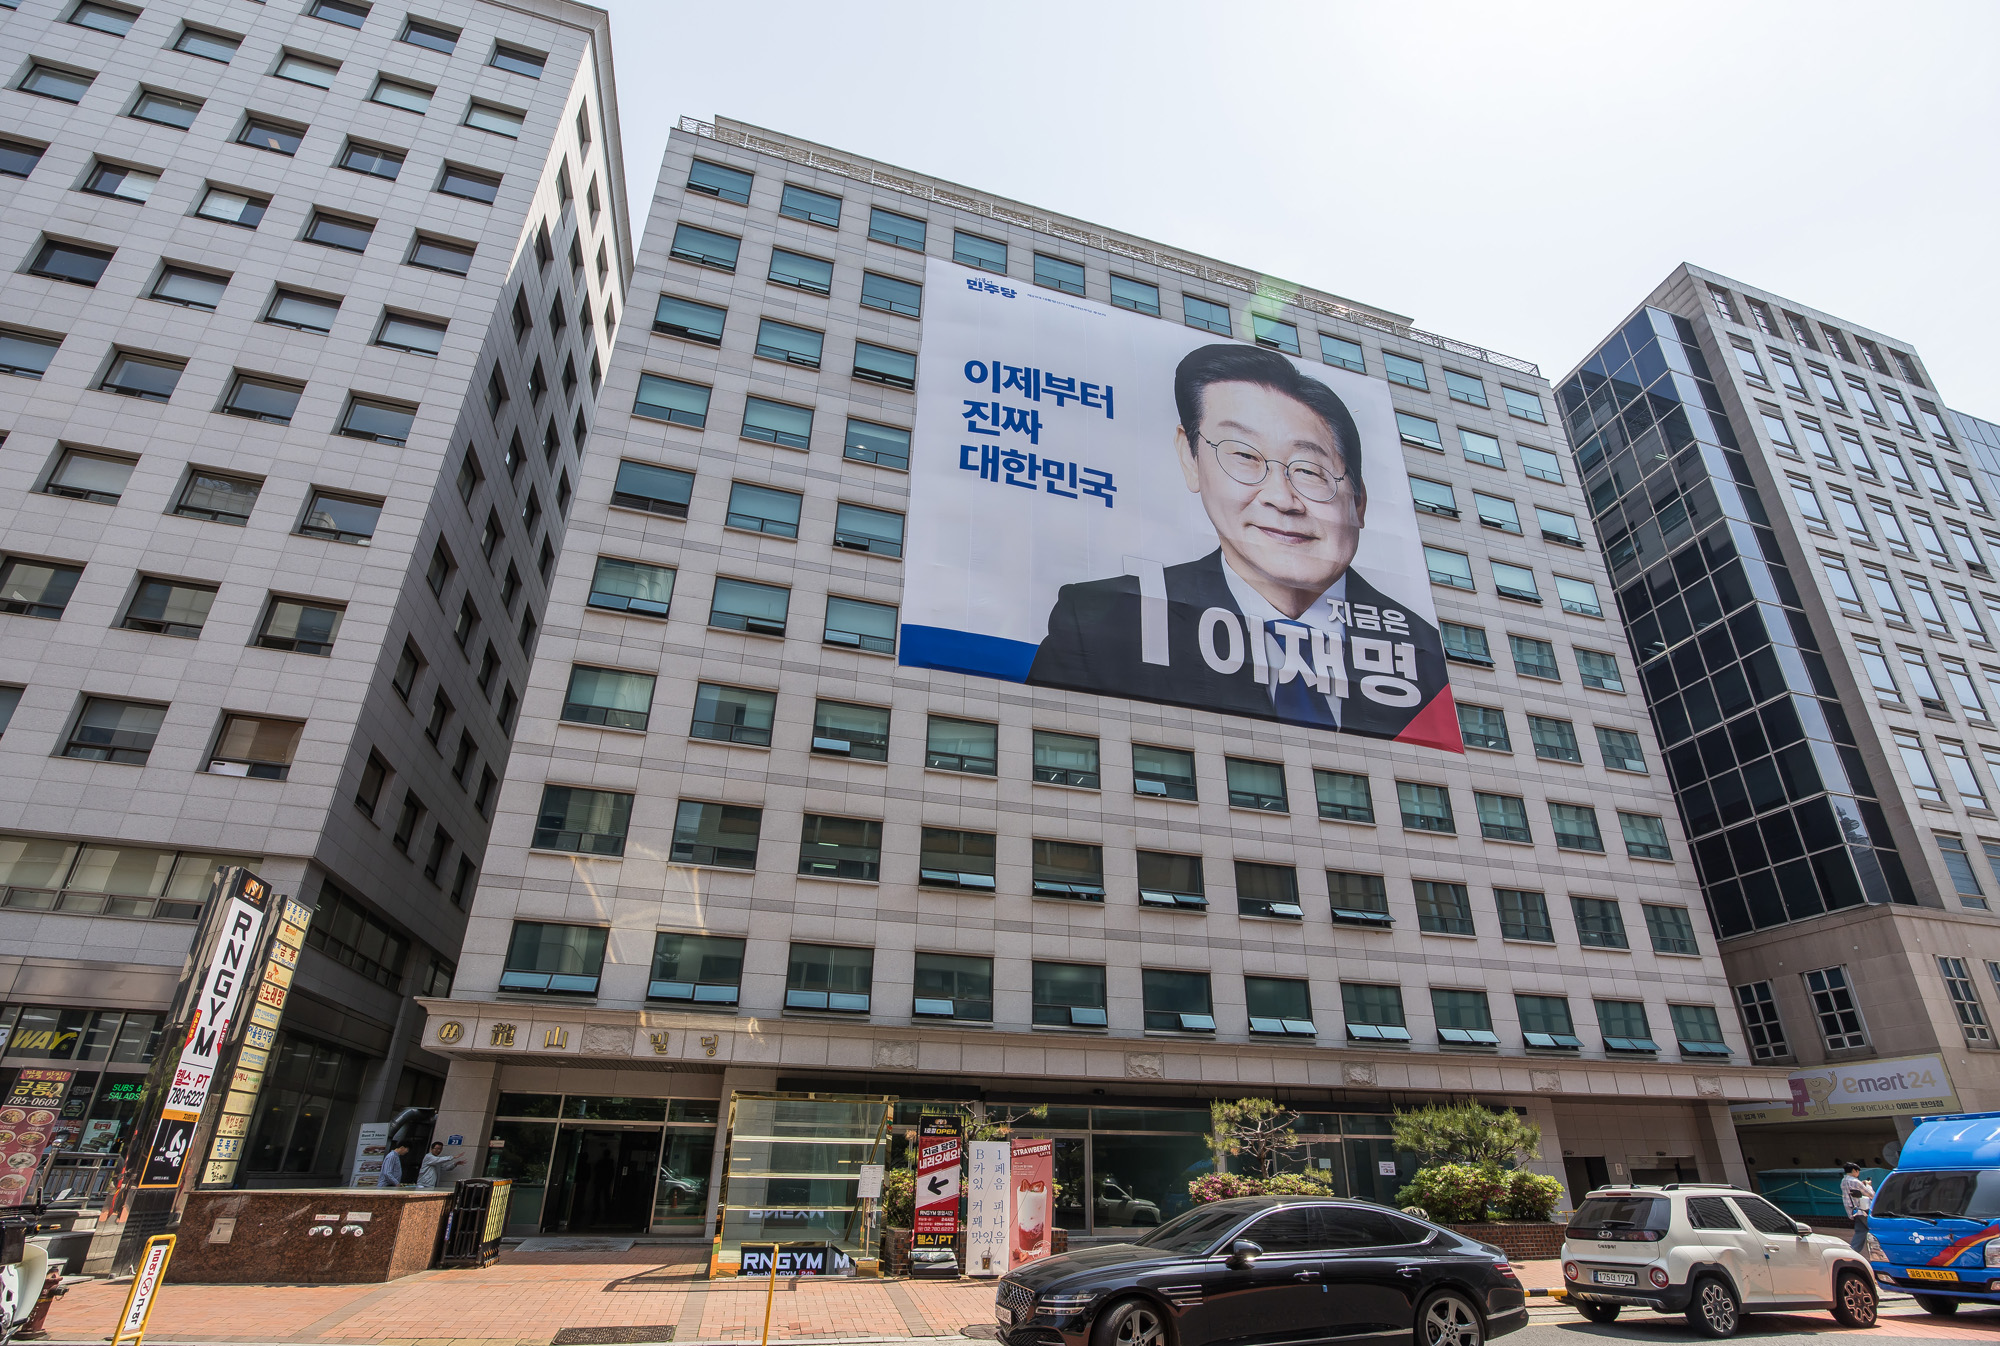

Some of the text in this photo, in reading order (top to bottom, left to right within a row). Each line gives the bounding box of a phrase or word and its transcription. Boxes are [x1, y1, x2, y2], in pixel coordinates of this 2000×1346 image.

[966, 279, 1018, 299] 민주당
[963, 359, 1115, 421] 이제부터
[961, 400, 1043, 445] 진짜
[959, 445, 1118, 509] 대한민국
[1122, 555, 1170, 667] 1
[1326, 598, 1410, 636] 지금은
[1198, 606, 1422, 708] 이재명
[280, 944, 297, 962] 금룡
[192, 909, 253, 1058] RNGYM
[266, 971, 274, 980] SK
[263, 984, 285, 1006] 노래방
[650, 1031, 719, 1057] 빌딩
[14, 1080, 52, 1097] 금룡
[112, 1083, 133, 1092] SUBS
[1842, 1069, 1937, 1094] emart24
[7, 1096, 59, 1107] 785-0609
[108, 1092, 140, 1100] SALADS
[168, 1087, 205, 1108] 780-6223
[1851, 1100, 1945, 1113] 언제 어디서나 이마트 편의점
[923, 1140, 956, 1156] 지금 당장
[1013, 1144, 1051, 1156] STRAWBERRY
[919, 1148, 960, 1169] 내려오세요!
[971, 1231, 1005, 1244] 맛있음
[147, 1249, 162, 1276] 금연
[743, 1252, 823, 1270] RNGYM
[1617, 1274, 1633, 1283] 1724
